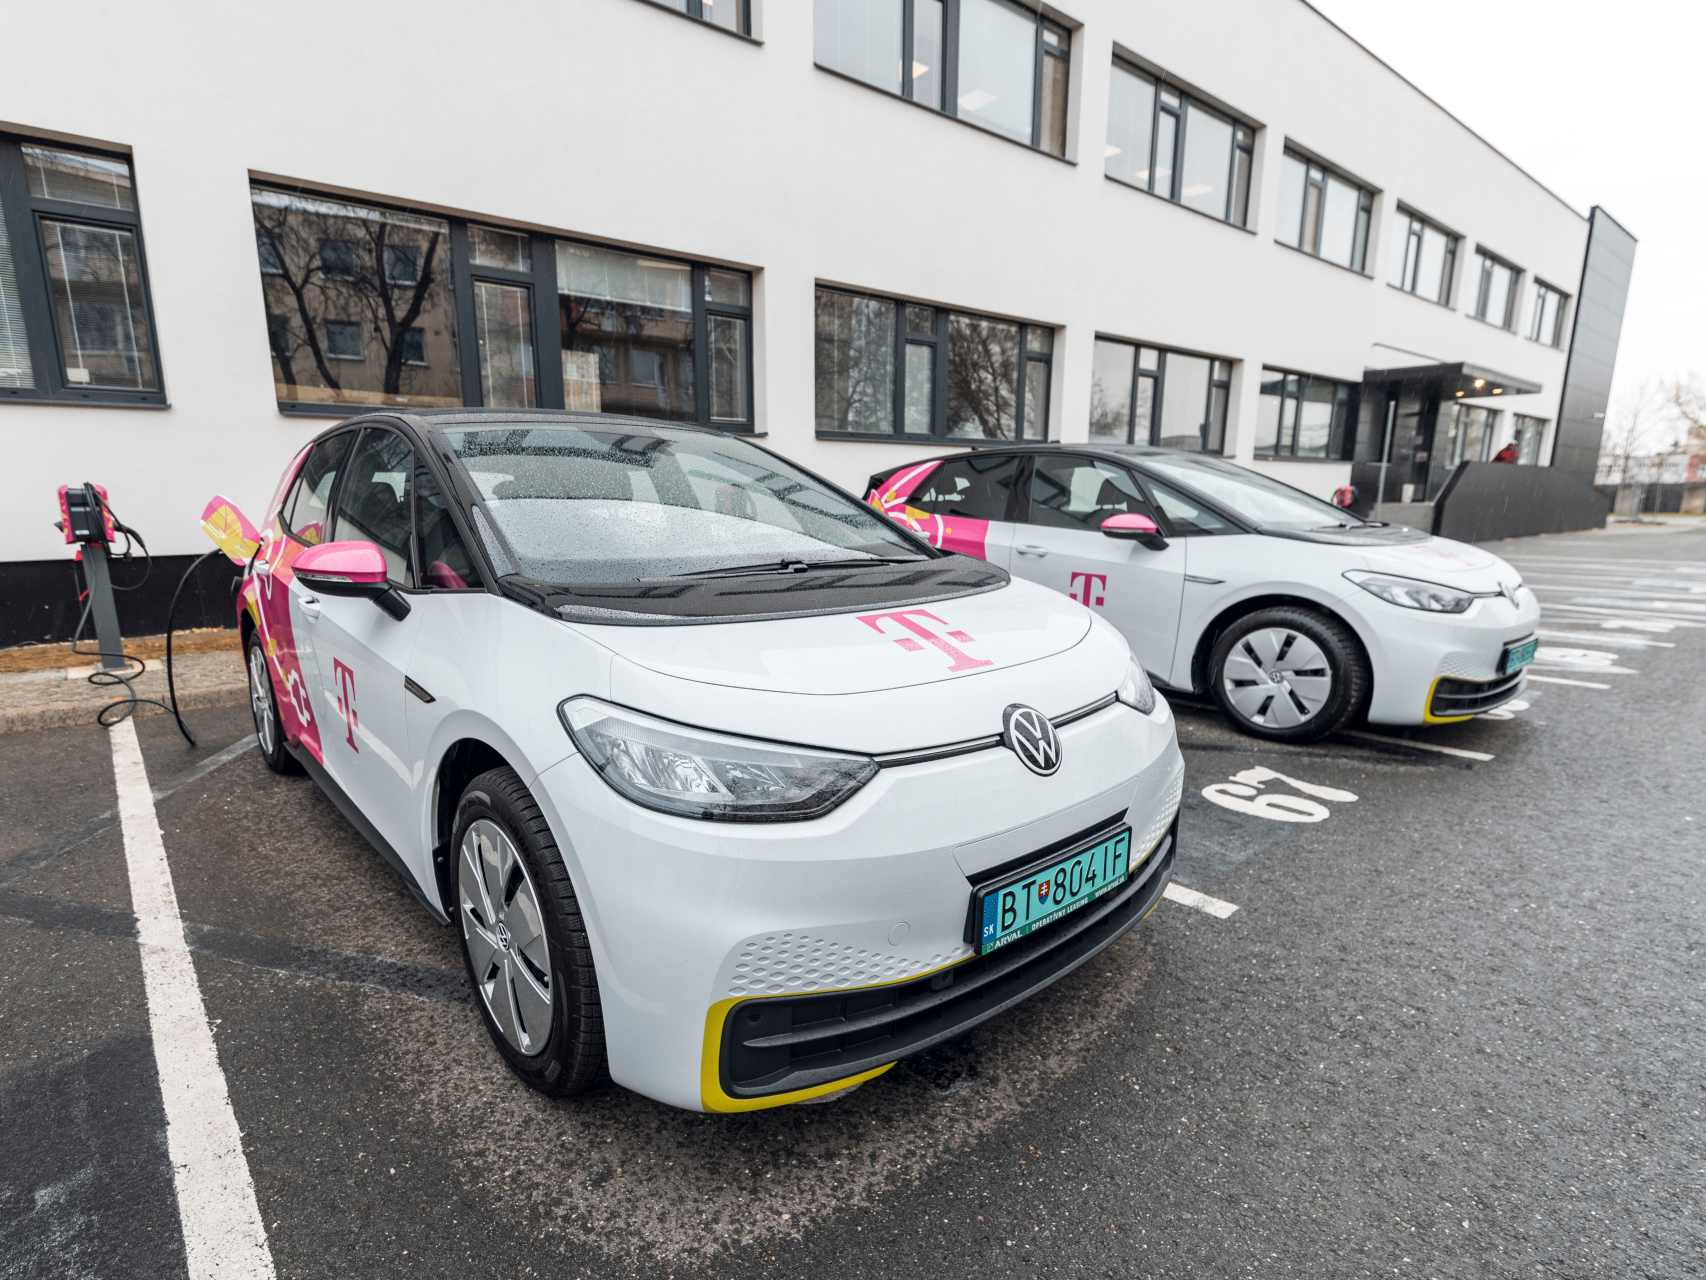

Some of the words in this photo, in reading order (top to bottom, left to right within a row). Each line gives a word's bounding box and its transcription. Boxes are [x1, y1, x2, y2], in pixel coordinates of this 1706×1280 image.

[857, 609, 993, 672] T
[333, 656, 359, 753] T
[1201, 766, 1359, 822] 67
[1002, 880, 1036, 931] BT
[1053, 836, 1125, 905] 804IF
[1067, 897, 1088, 913] LEASING
[984, 923, 994, 937] SK
[995, 930, 1022, 949] ARVAL
